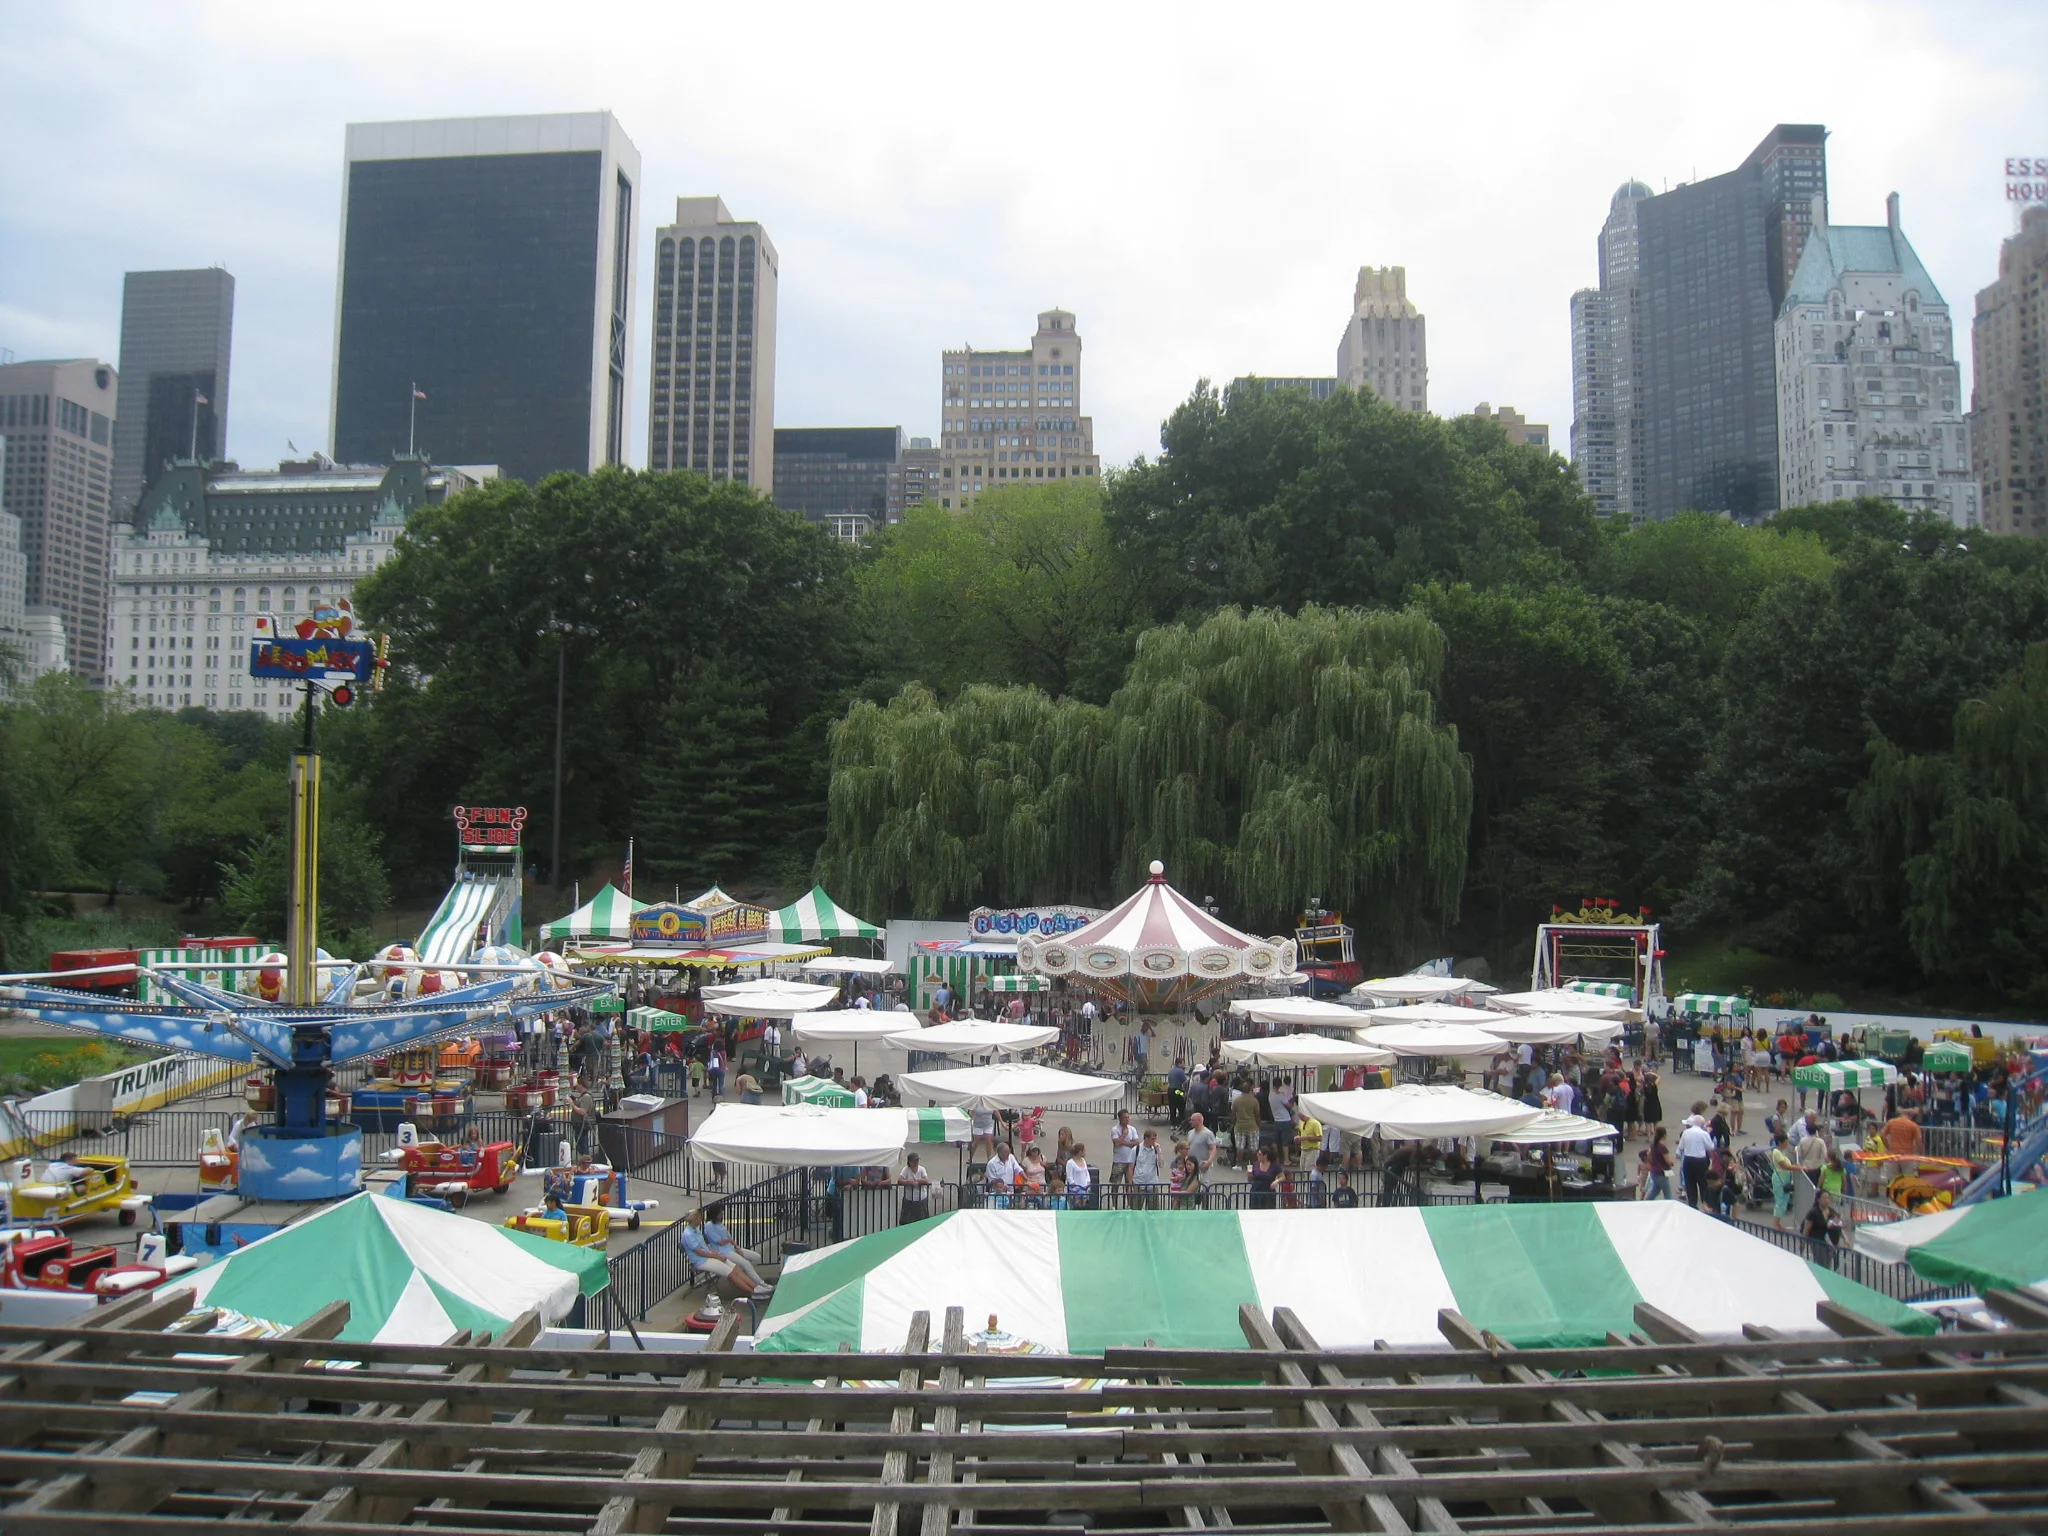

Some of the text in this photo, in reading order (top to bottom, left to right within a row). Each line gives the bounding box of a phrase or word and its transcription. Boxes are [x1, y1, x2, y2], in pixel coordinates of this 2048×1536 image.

[470, 807, 511, 823] FUN
[463, 827, 518, 844] SLIDE
[975, 913, 1039, 934] RISING
[654, 1015, 682, 1026] ENTER
[1934, 1054, 1957, 1065] EXIT
[112, 1058, 176, 1099] TRUMP
[1795, 1068, 1826, 1083] ENTER
[816, 1095, 844, 1108] EXIT
[401, 1131, 412, 1144] 3
[21, 1164, 31, 1179] 5
[592, 1186, 598, 1203] 1
[142, 1244, 157, 1262] 7
